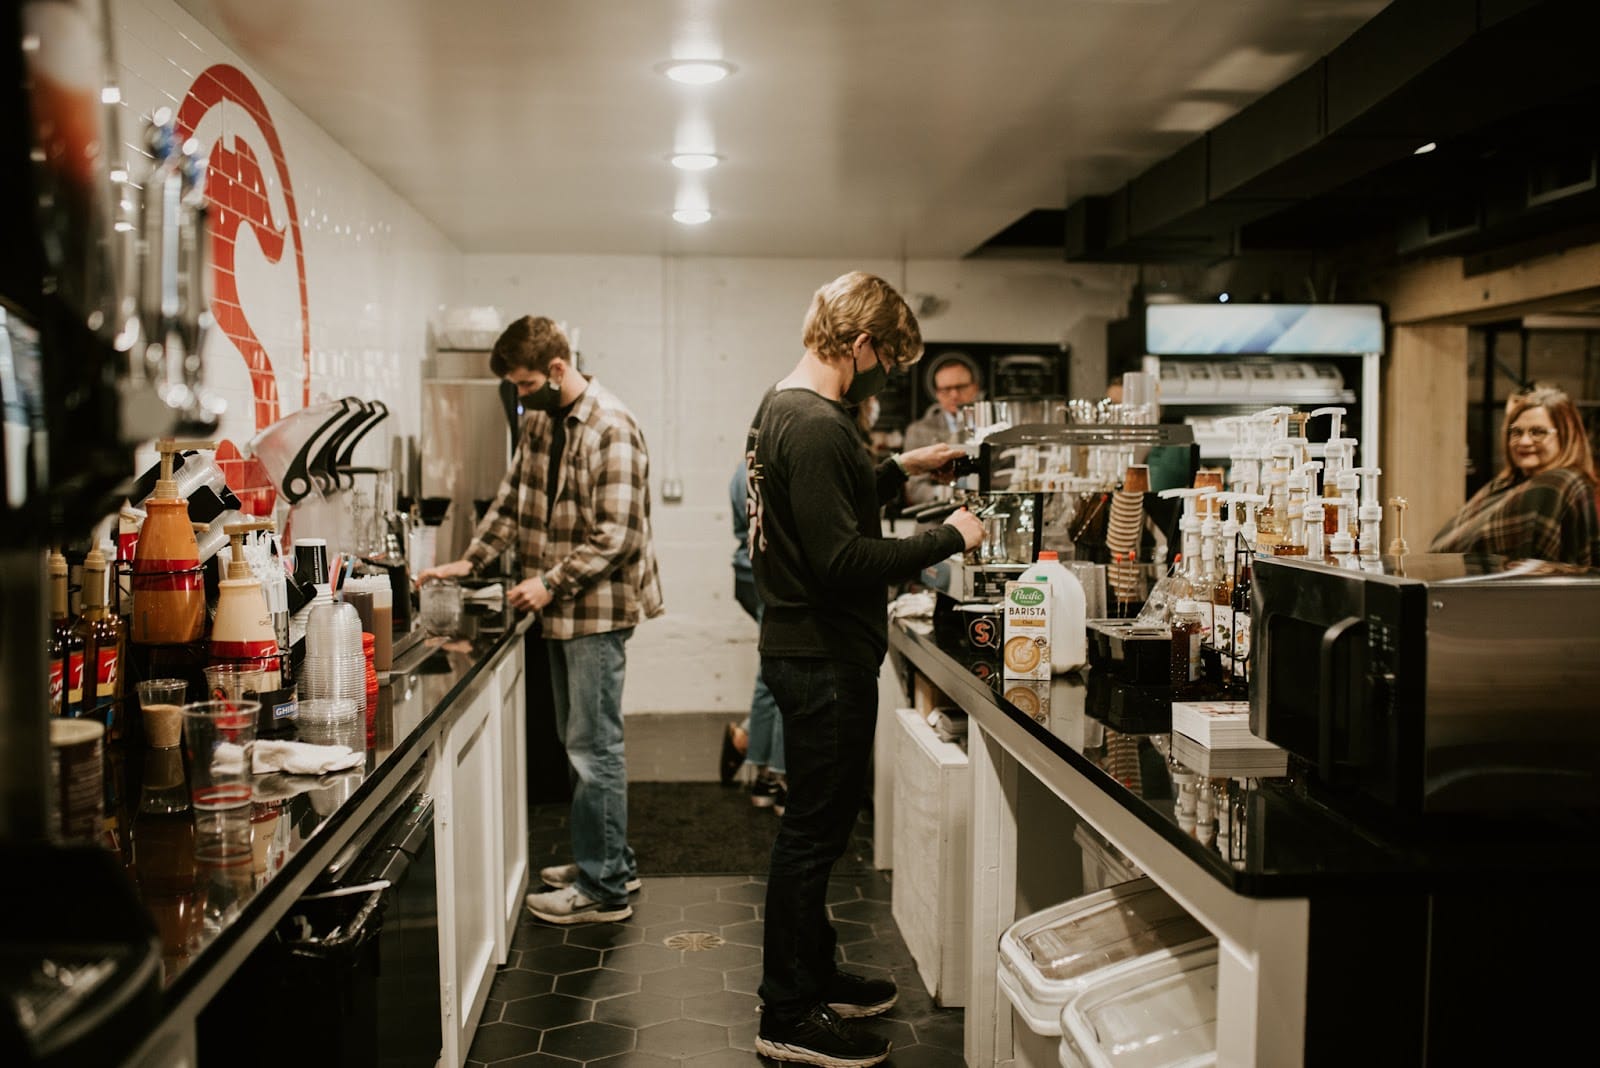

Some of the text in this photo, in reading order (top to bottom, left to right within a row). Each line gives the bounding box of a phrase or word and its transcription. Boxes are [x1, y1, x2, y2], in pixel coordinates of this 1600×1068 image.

[1014, 589, 1042, 600] Pacific
[1009, 607, 1046, 616] BARISTA
[975, 622, 990, 643] S
